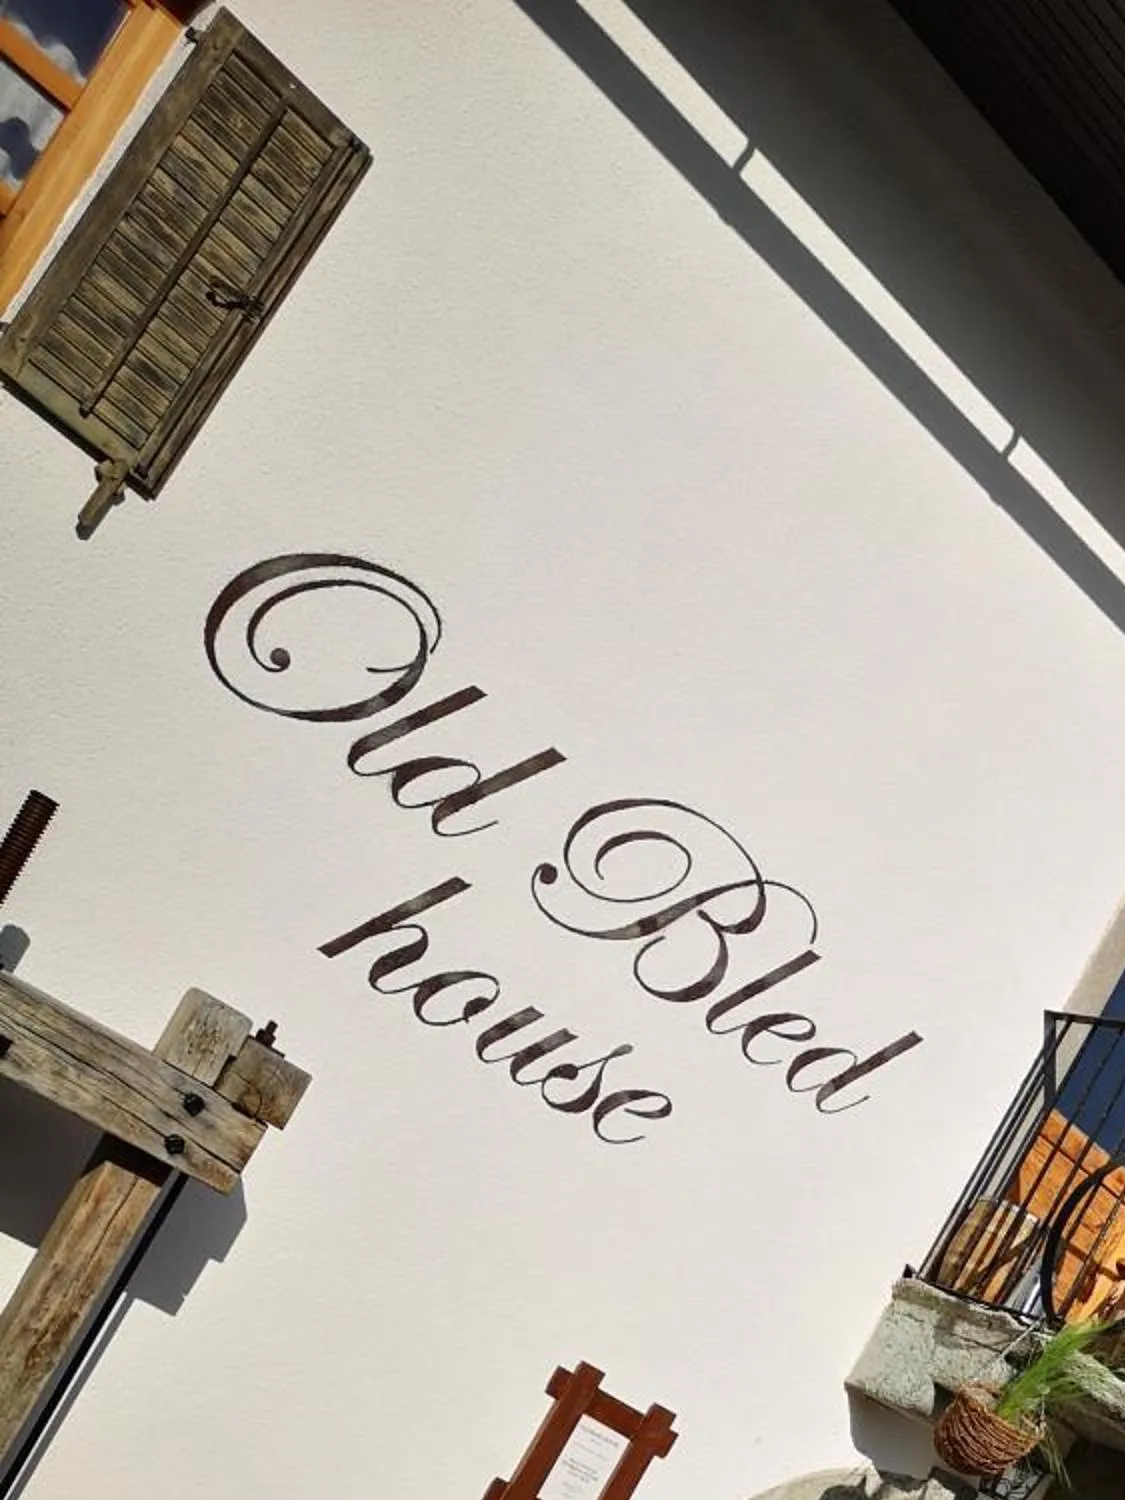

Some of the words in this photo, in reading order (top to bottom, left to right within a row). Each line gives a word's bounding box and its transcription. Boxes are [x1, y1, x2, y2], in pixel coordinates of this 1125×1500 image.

[204, 553, 567, 836] Old
[531, 798, 923, 1113] Bled
[317, 876, 672, 1144] house
